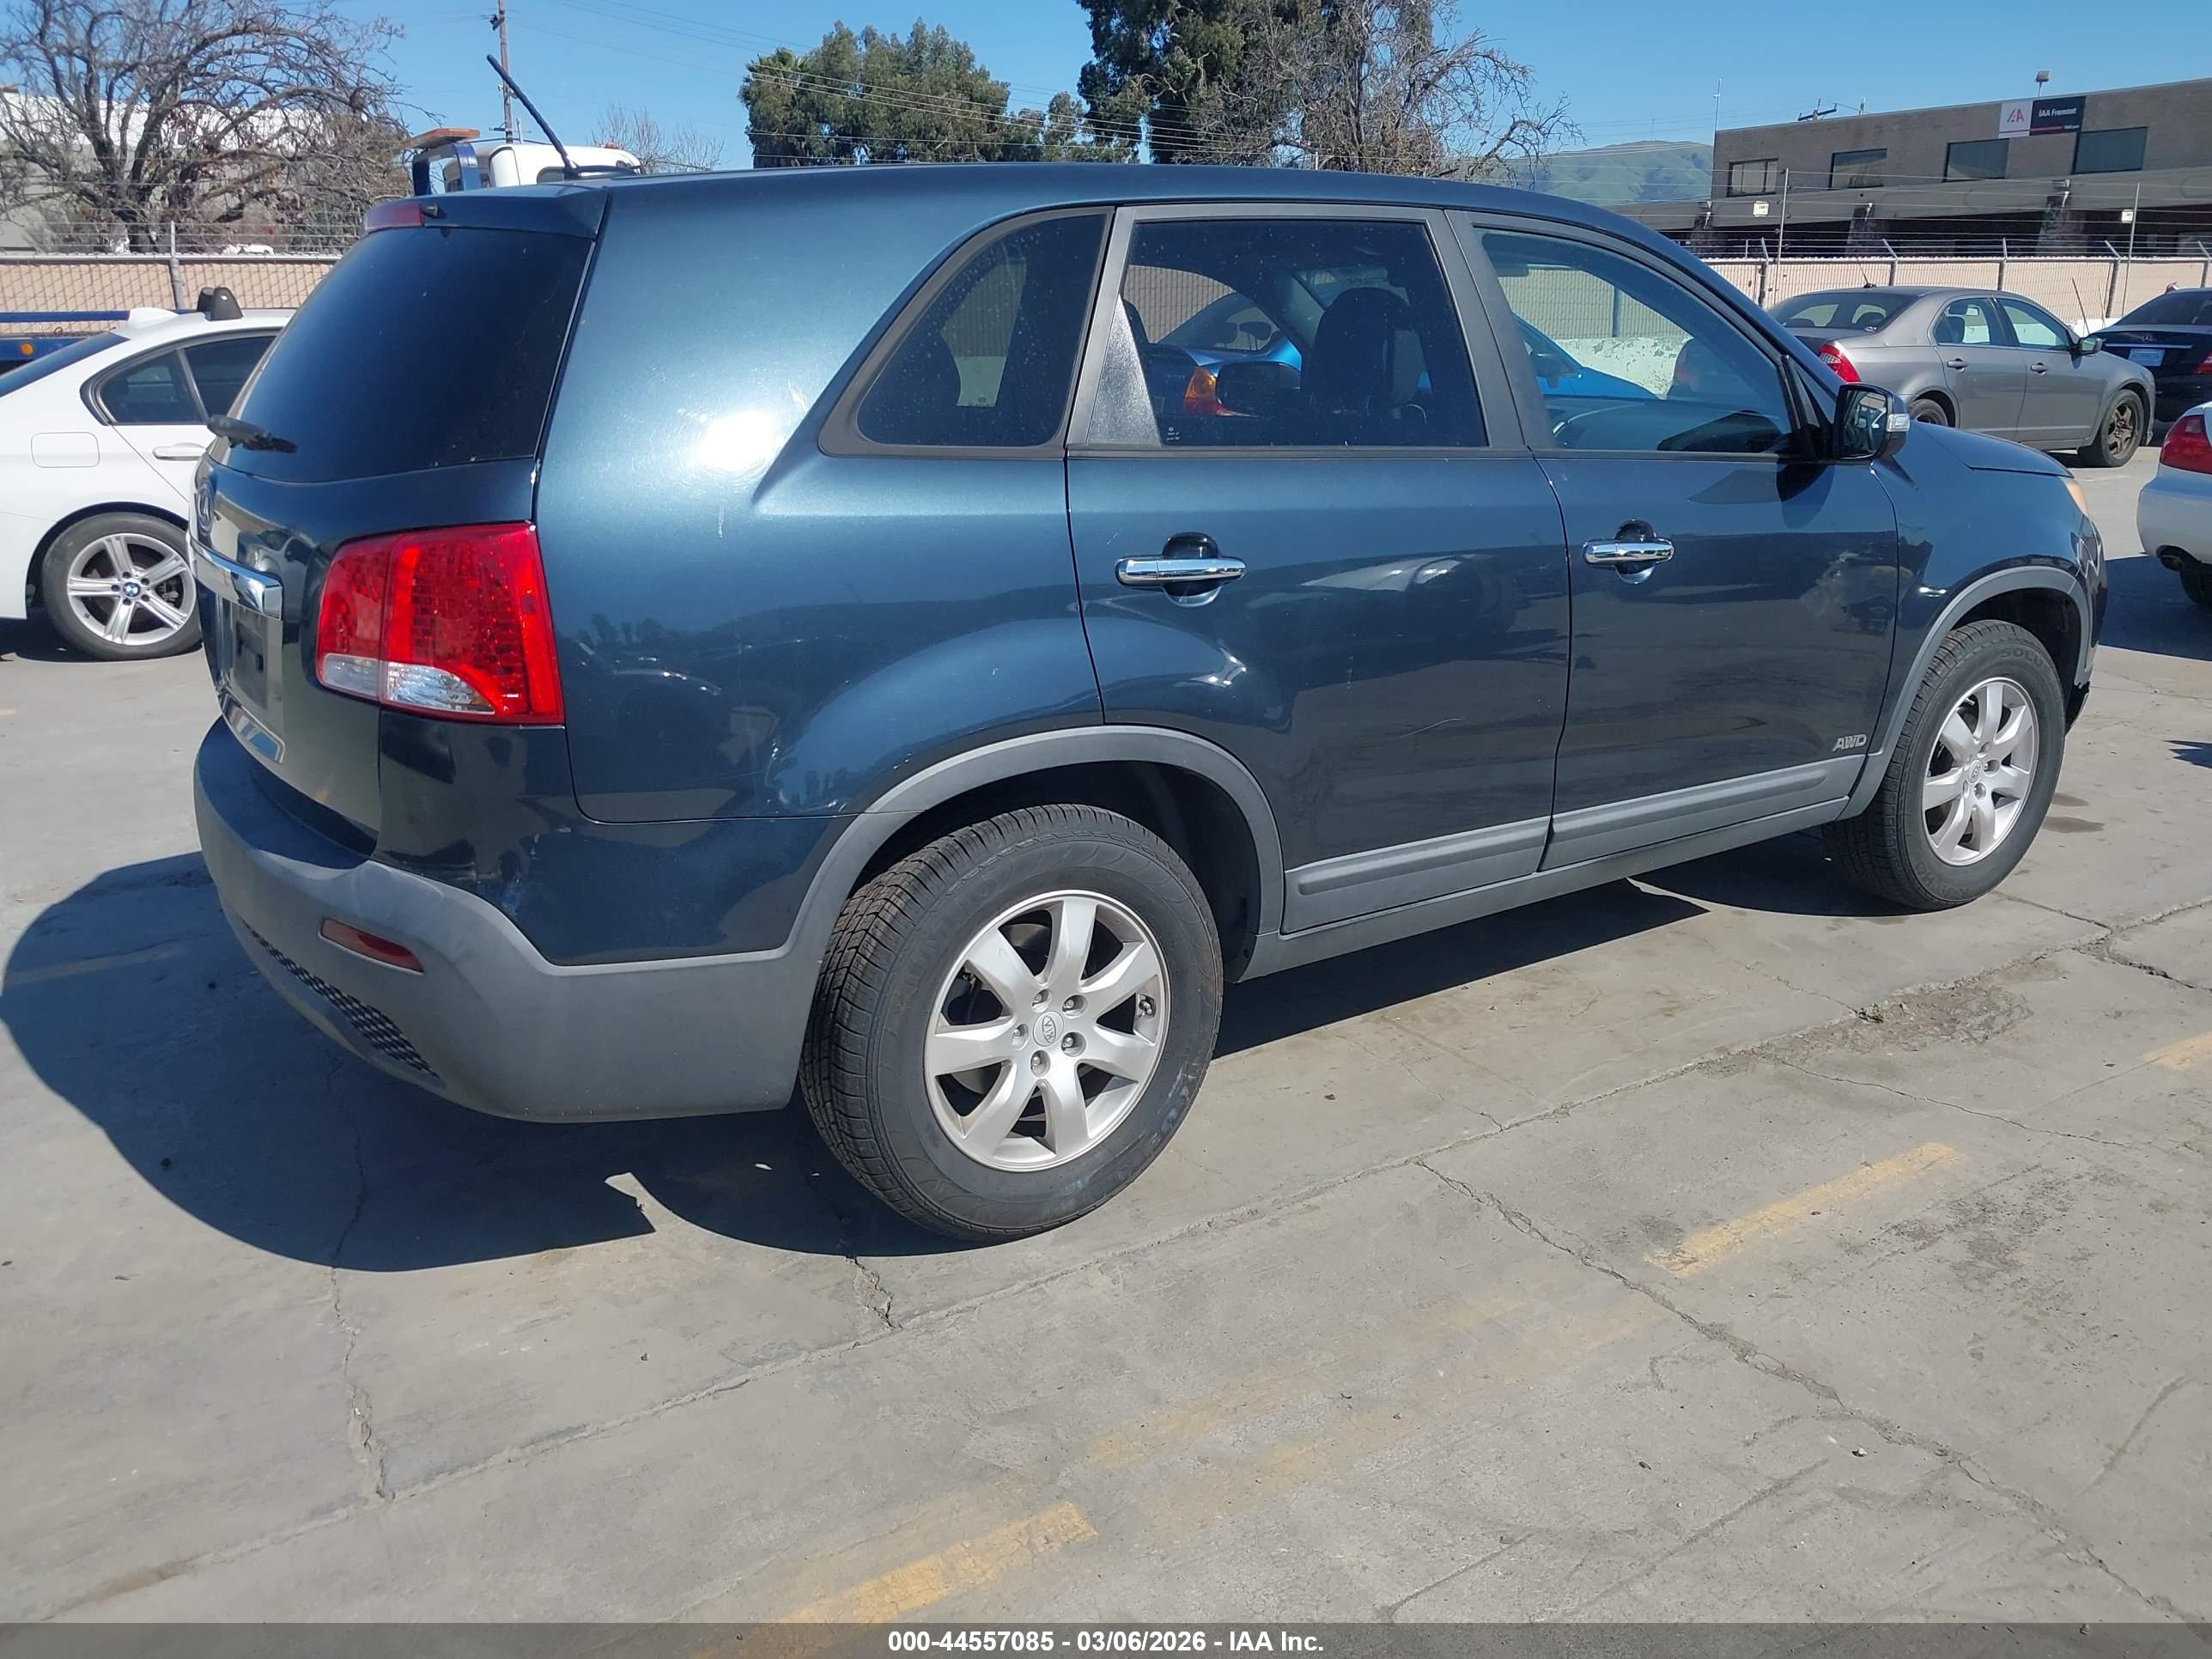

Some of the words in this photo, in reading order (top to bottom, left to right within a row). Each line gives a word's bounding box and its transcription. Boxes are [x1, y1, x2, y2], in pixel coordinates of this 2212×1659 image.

[2039, 109, 2051, 118] IAA
[1832, 734, 1868, 751] AWD
[1043, 1017, 1055, 1042] KIA
